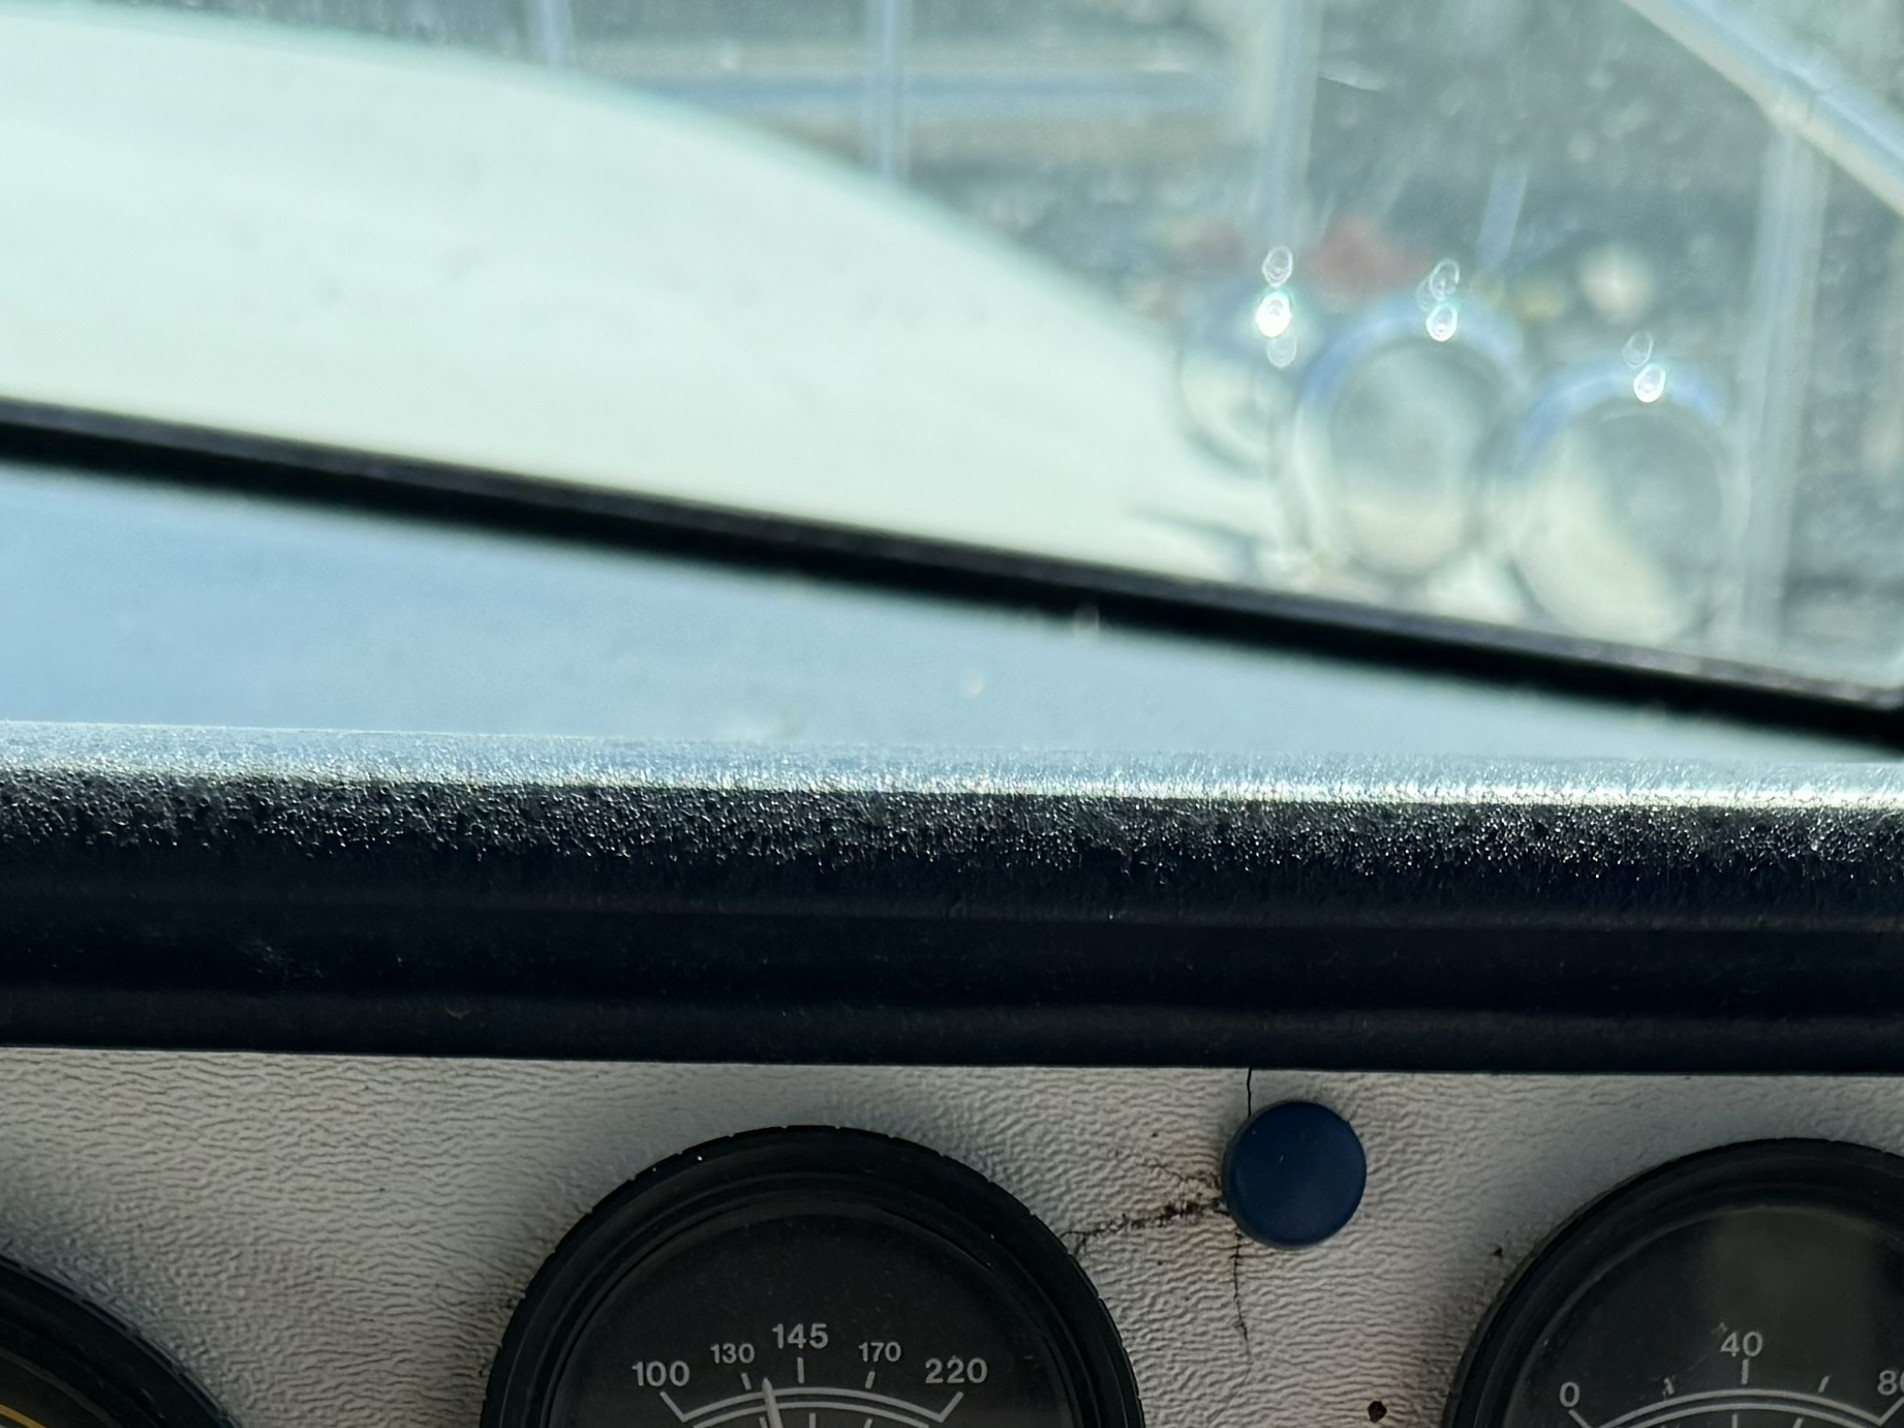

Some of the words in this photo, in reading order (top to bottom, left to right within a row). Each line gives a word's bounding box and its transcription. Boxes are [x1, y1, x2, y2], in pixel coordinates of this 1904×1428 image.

[772, 1324, 829, 1350] 145
[1720, 1332, 1763, 1357] 40
[710, 1343, 755, 1364] 130
[858, 1342, 902, 1363] 170
[632, 1361, 690, 1388] 100
[925, 1357, 988, 1385] 220
[1559, 1381, 1581, 1408] 0
